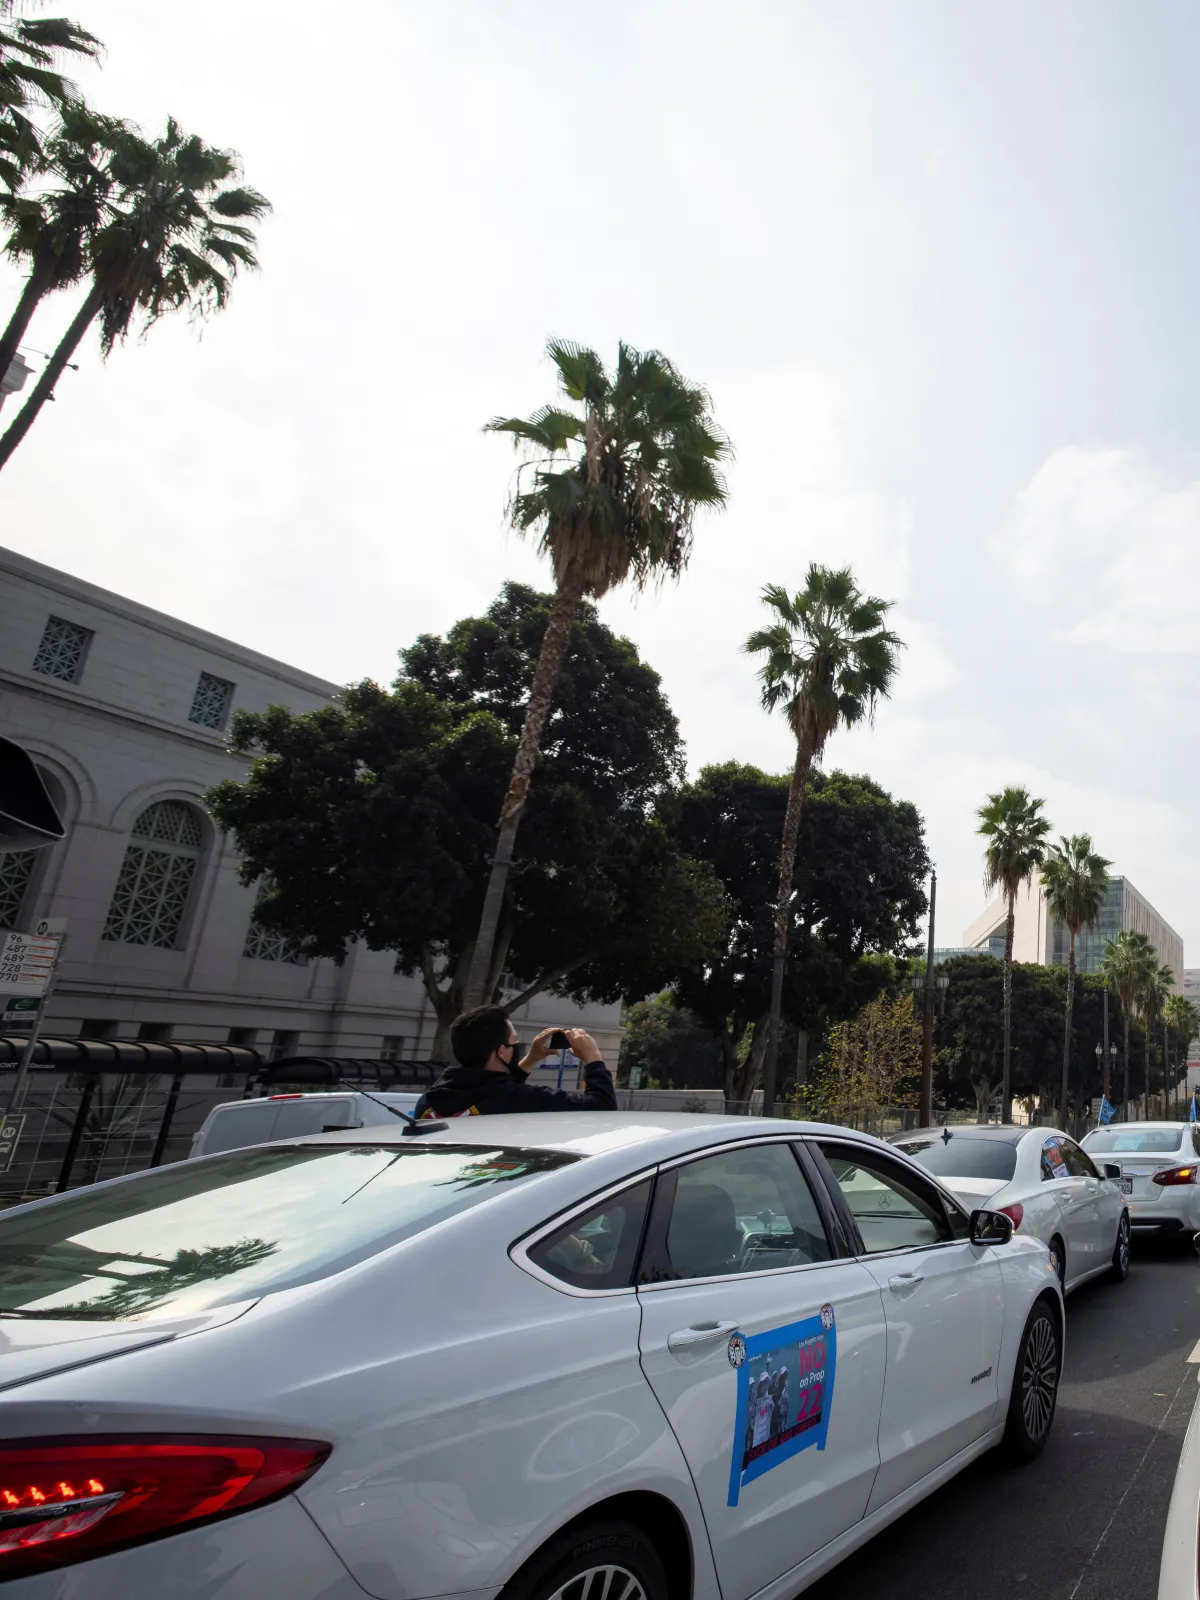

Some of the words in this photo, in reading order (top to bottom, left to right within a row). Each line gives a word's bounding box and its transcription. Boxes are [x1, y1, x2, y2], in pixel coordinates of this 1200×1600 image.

[10, 934, 23, 943] 96
[6, 944, 28, 953] 487
[4, 953, 25, 963] 489
[1, 962, 21, 972] 728
[0, 972, 19, 982] 770
[799, 1341, 825, 1376] NO
[799, 1377, 809, 1388] on
[809, 1370, 825, 1384] Prop
[796, 1383, 822, 1422] 22
[767, 1436, 779, 1451] OF
[780, 1429, 793, 1444] GIG
